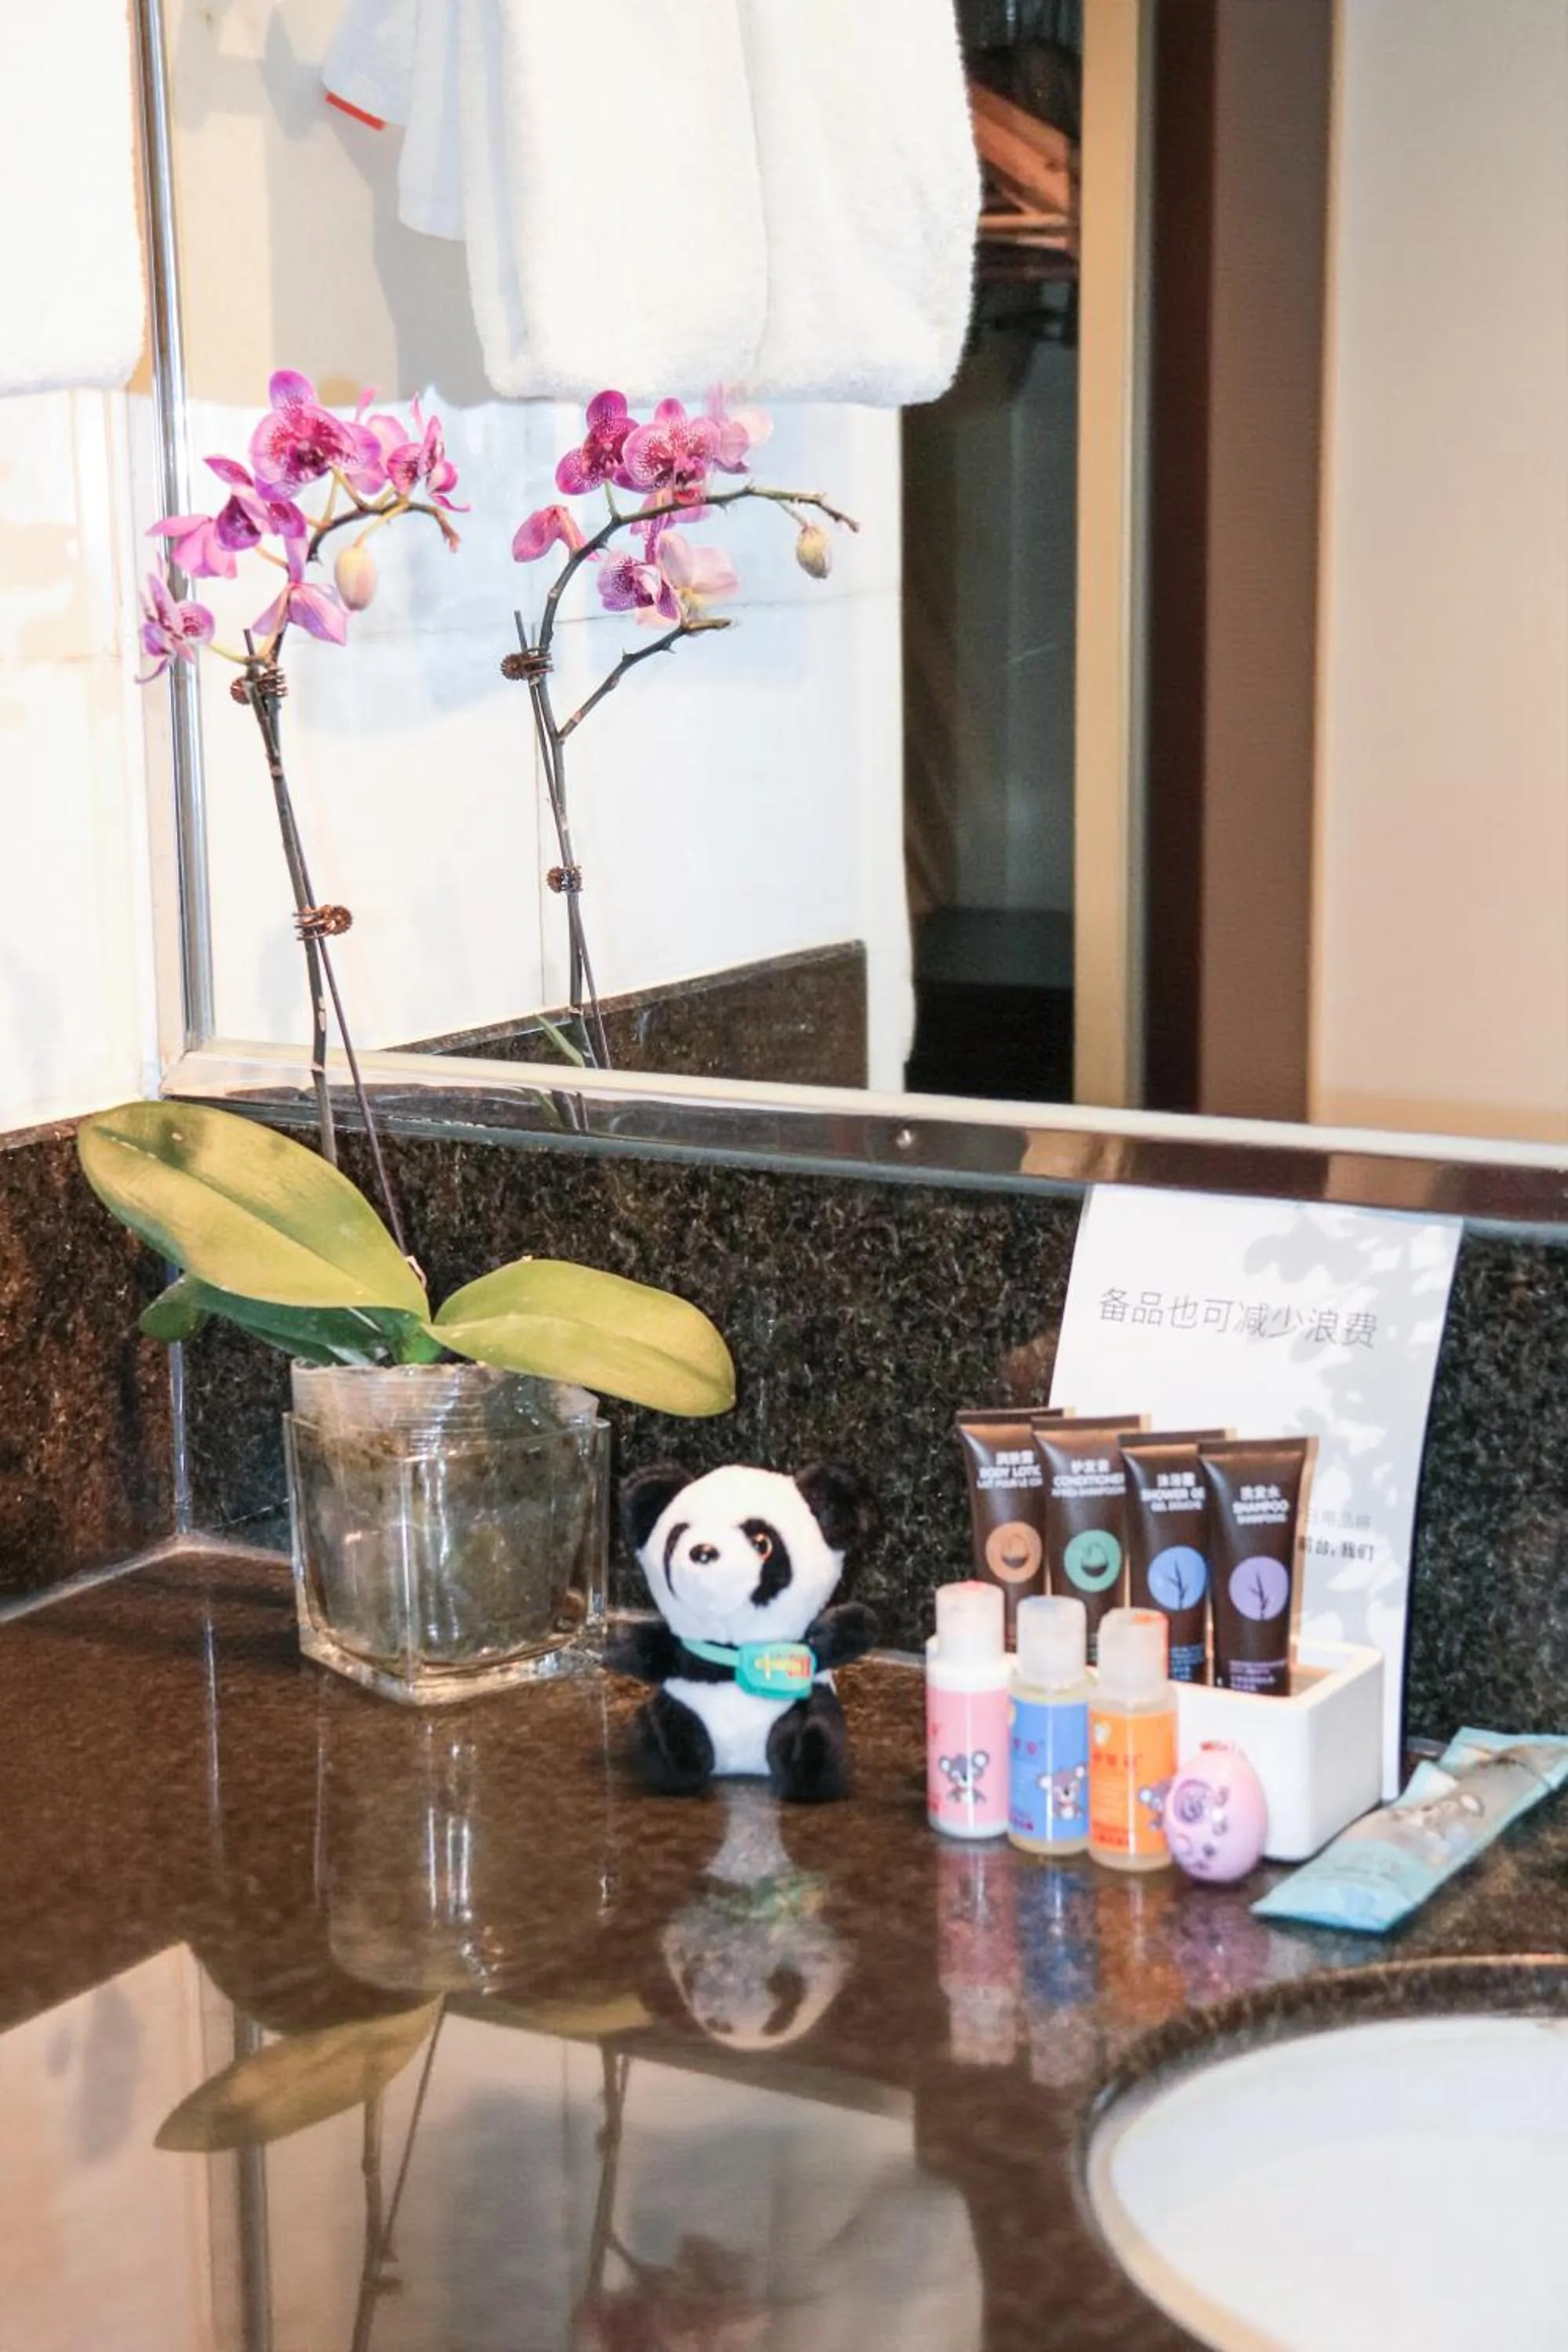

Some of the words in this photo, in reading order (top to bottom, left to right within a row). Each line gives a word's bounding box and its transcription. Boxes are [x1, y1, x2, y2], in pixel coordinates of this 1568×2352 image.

[1099, 1287, 1377, 1349] 备品也可减少浪费
[979, 1467, 1010, 1479] BODY
[1156, 1472, 1196, 1487] 沐浴露
[1141, 1488, 1189, 1501] SHOWER
[1240, 1484, 1280, 1501] 洗发水
[1232, 1499, 1290, 1515] SHAMPOO
